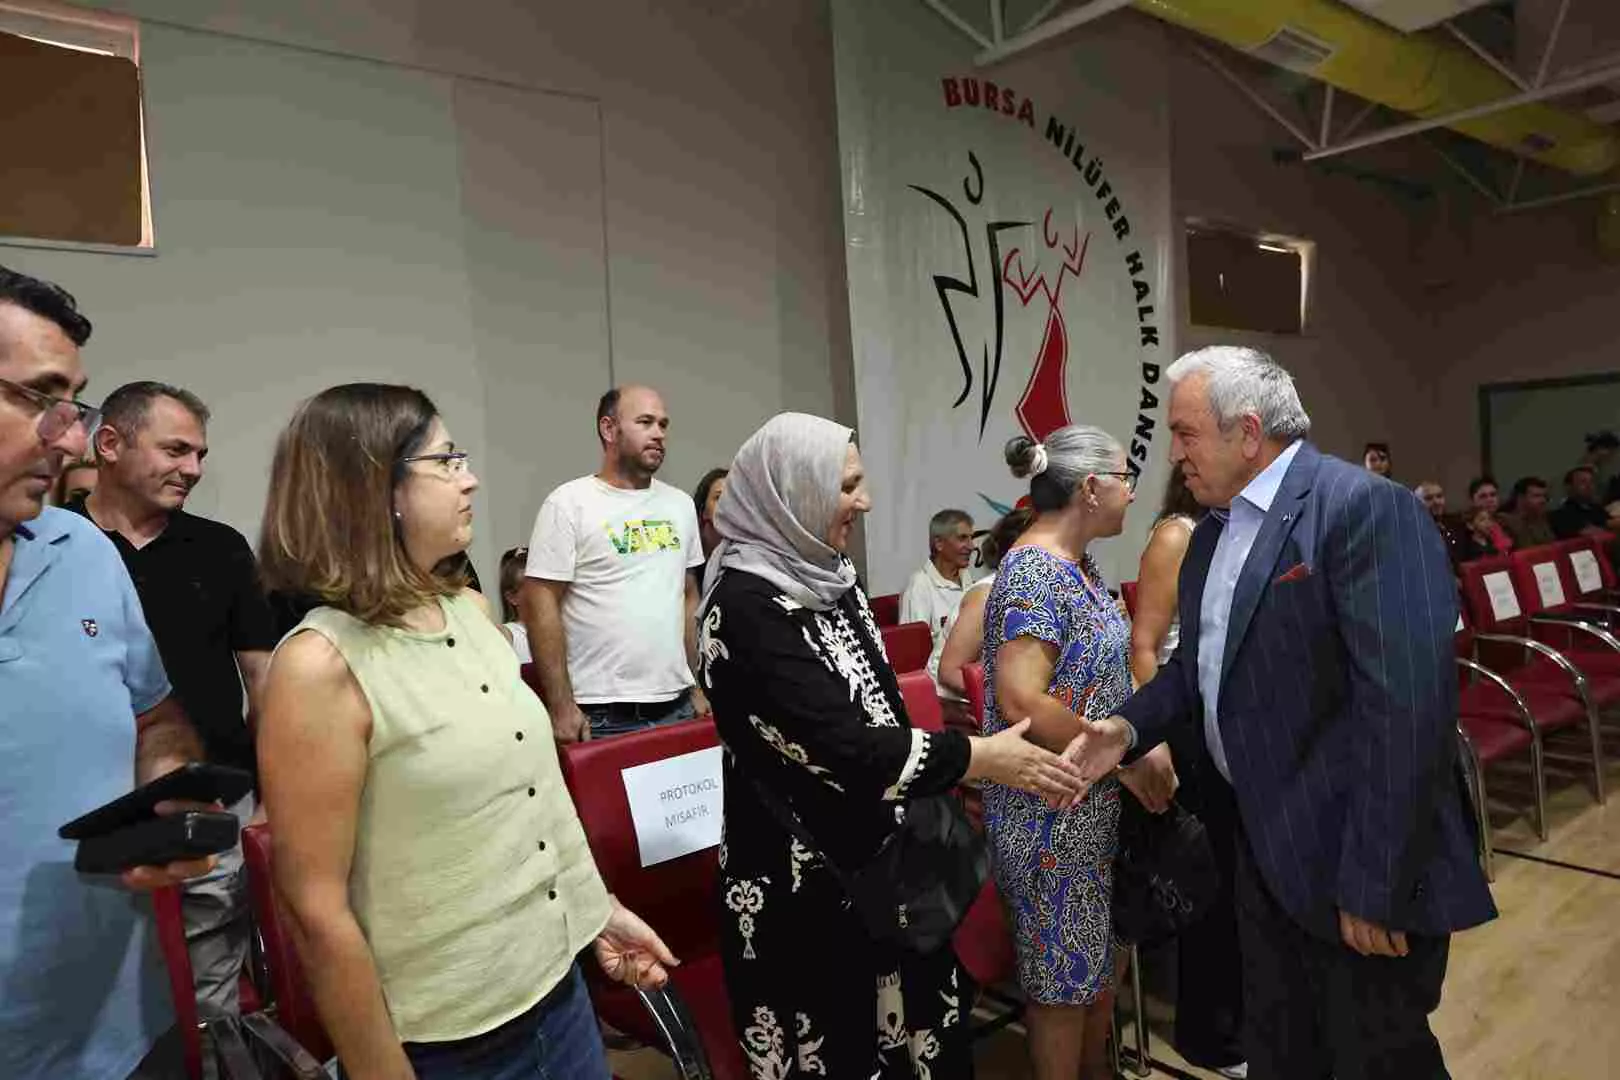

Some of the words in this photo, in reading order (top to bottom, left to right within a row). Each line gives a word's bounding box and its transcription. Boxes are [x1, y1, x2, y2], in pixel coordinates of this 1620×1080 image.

[942, 76, 1035, 128] BURSA
[1045, 115, 1130, 241] NİLÜFER
[1125, 250, 1159, 347] HALK
[659, 777, 719, 803] PROTOKOL
